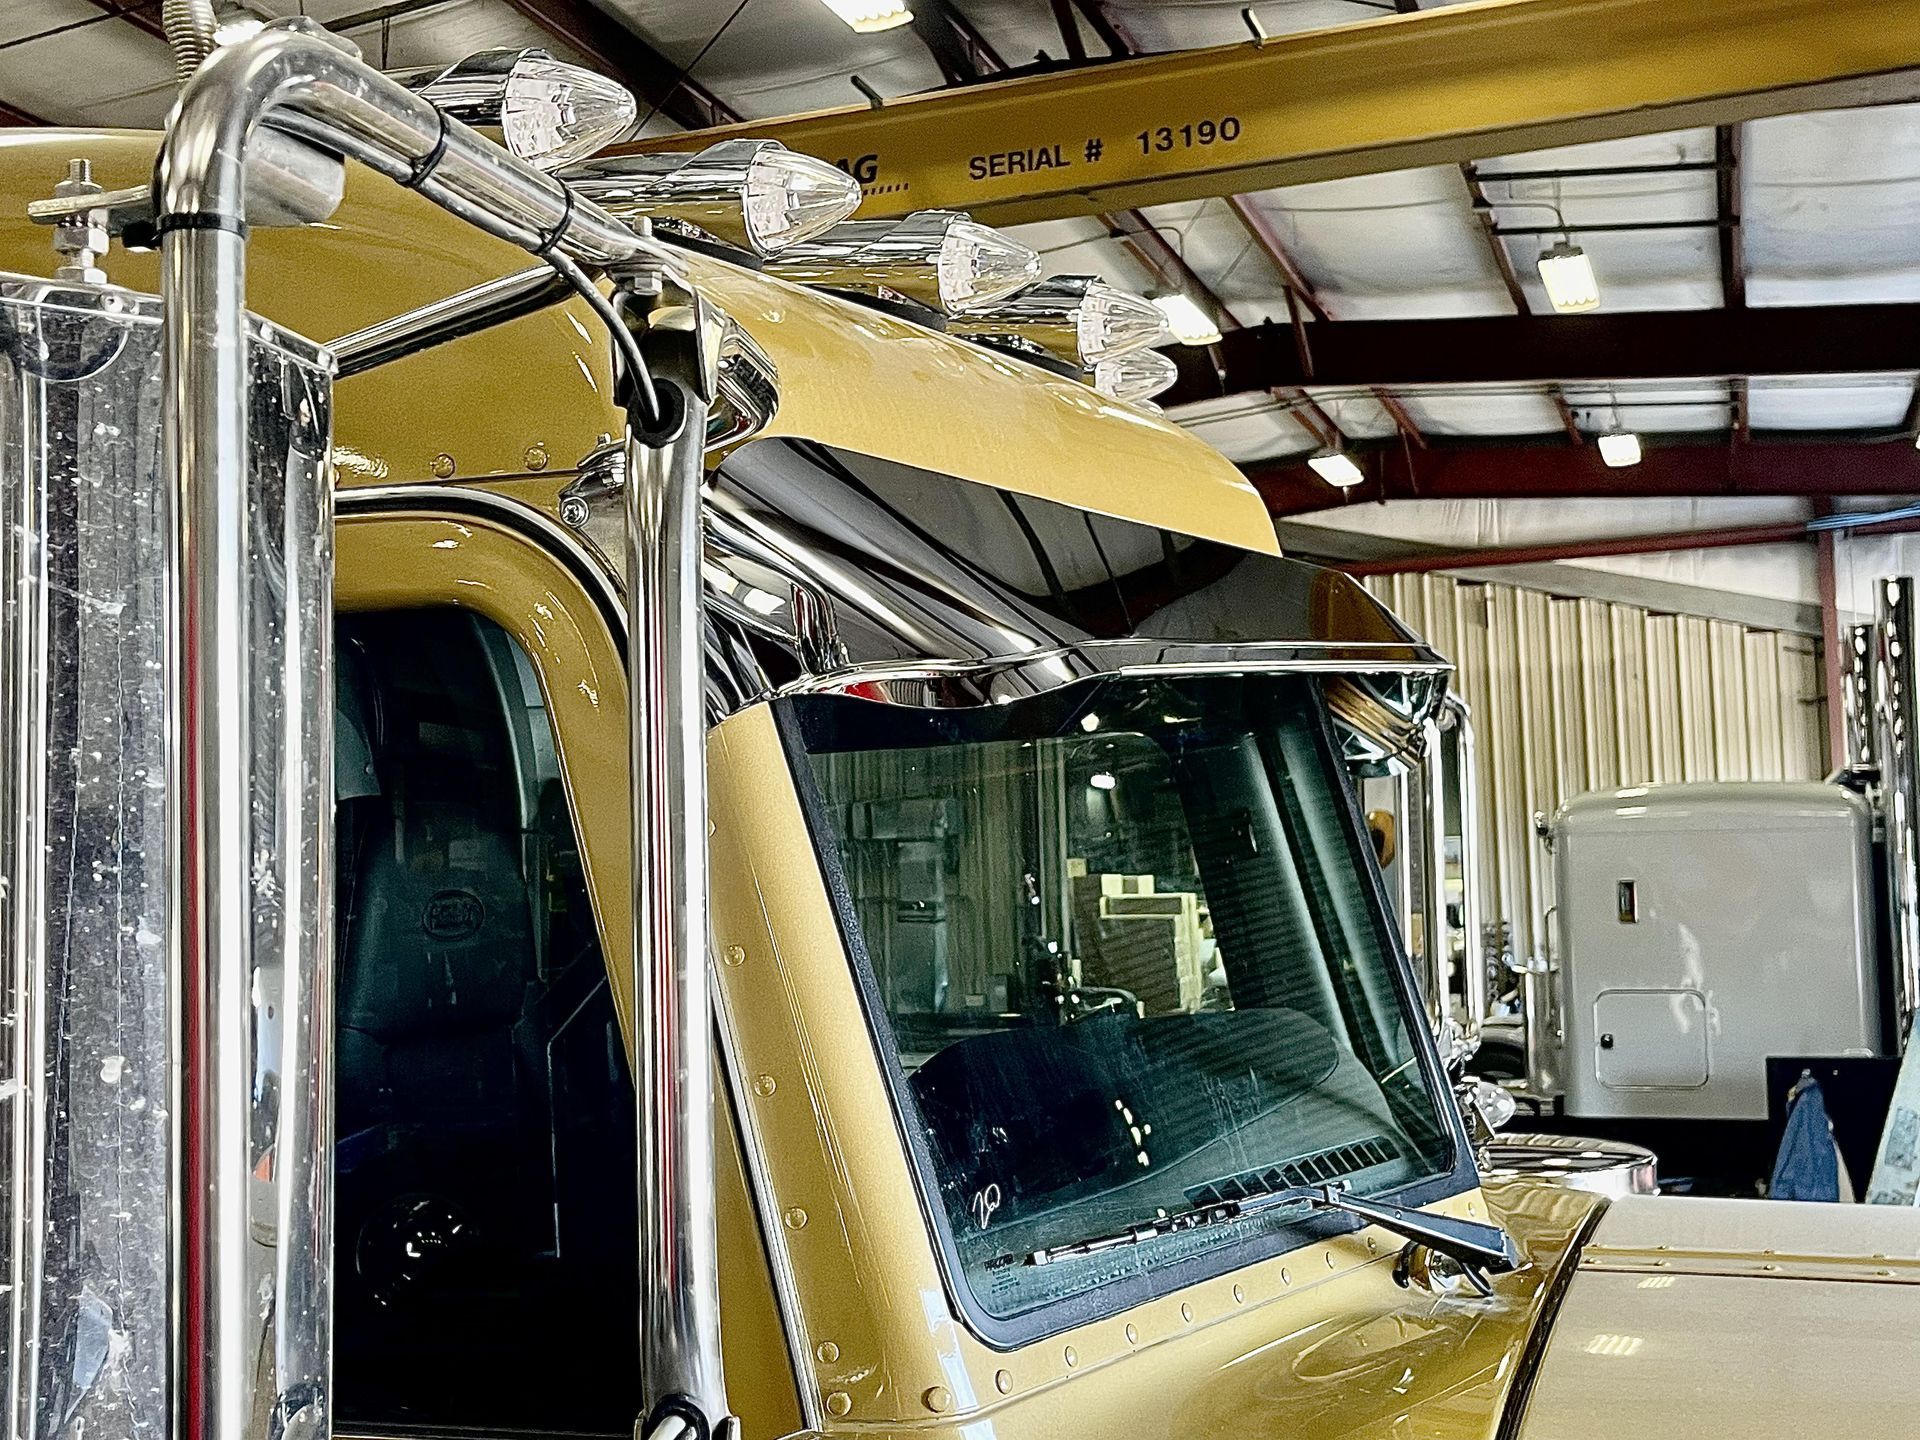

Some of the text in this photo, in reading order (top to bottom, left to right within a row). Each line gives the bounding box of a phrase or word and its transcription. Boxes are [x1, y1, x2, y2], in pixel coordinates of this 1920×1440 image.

[969, 116, 1241, 181] SERIAL # 13190
